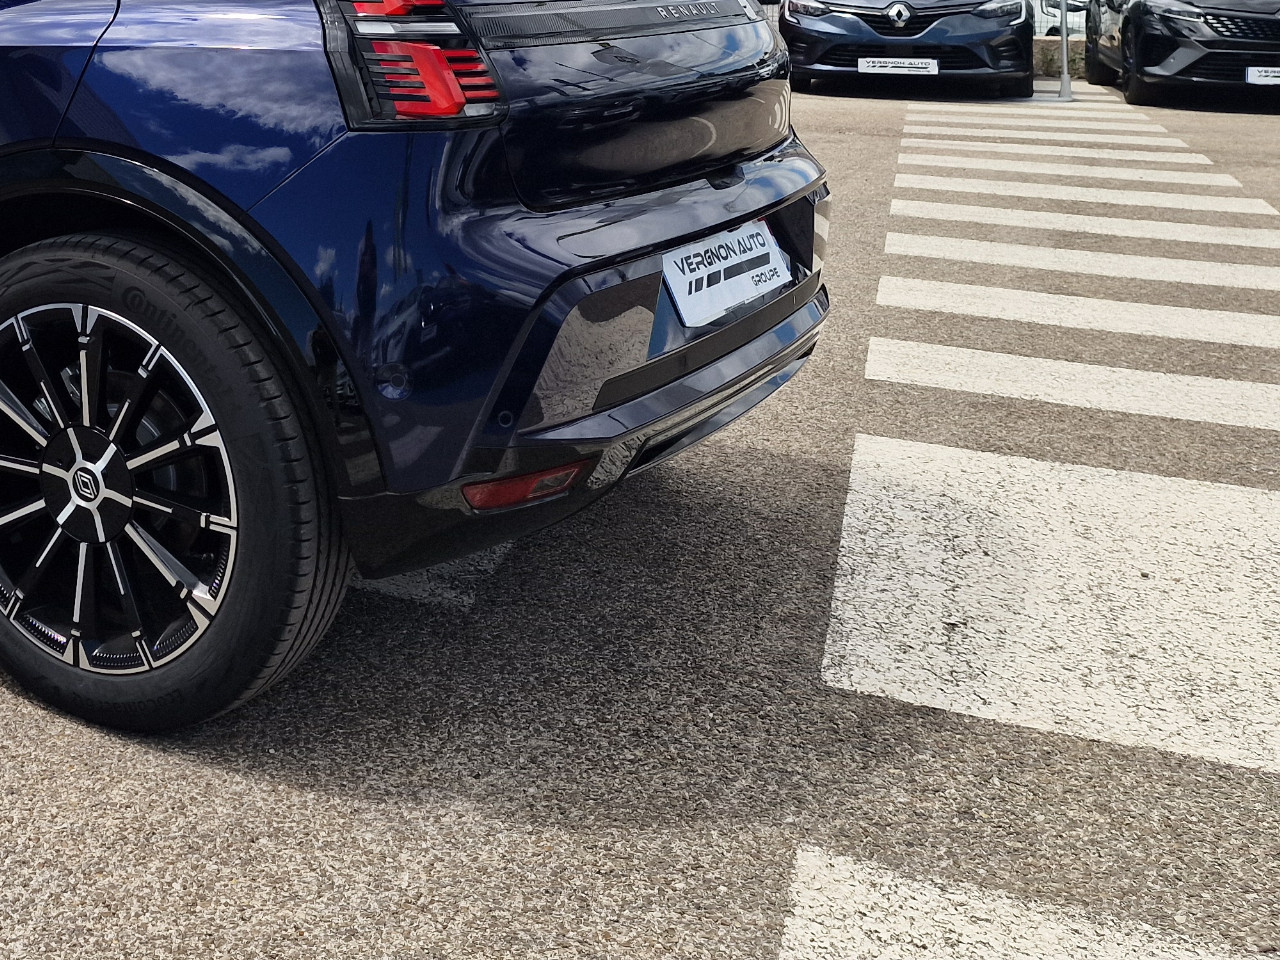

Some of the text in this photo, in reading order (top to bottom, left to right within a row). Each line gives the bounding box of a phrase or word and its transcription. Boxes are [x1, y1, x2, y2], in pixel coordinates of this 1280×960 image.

[656, 2, 720, 20] RENAULT
[673, 231, 766, 276] VERGNON AUTO
[751, 267, 781, 287] GROUPE
